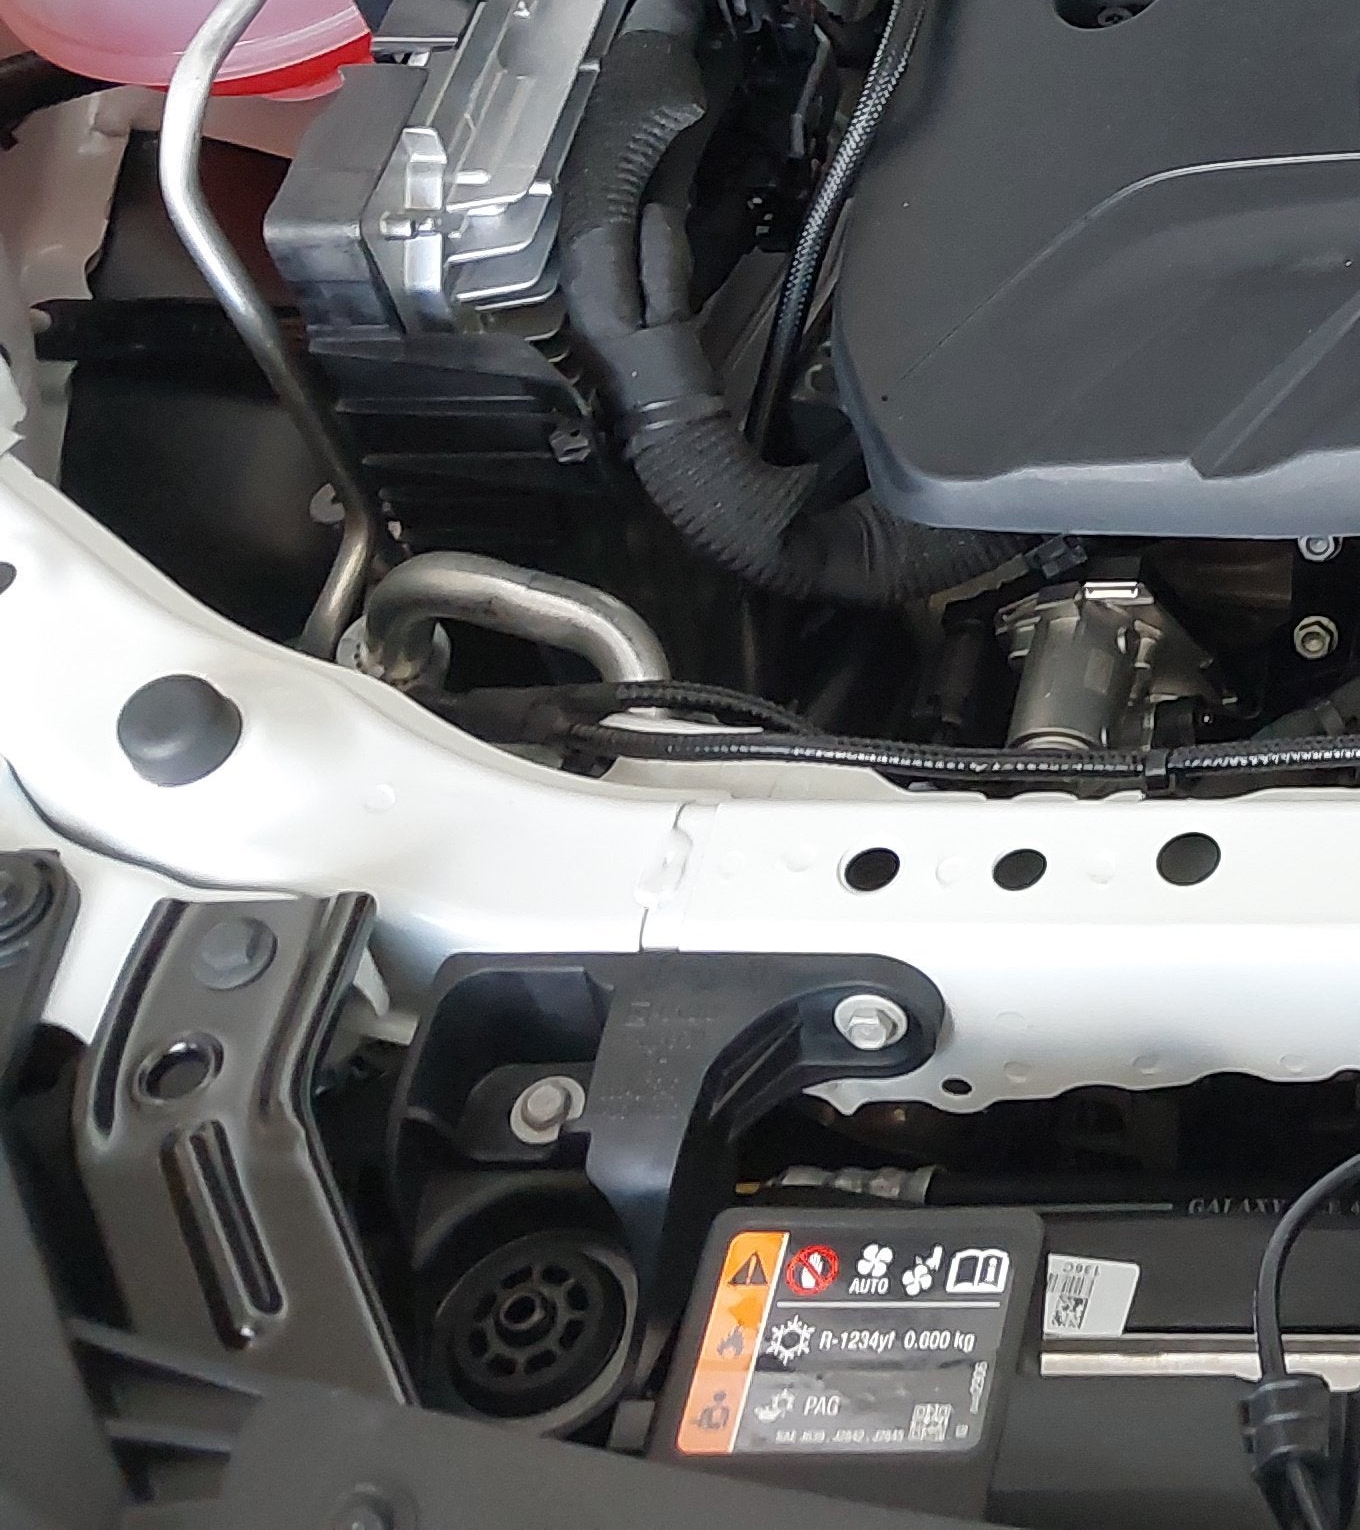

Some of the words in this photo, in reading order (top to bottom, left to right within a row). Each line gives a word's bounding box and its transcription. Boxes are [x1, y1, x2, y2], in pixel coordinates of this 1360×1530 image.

[849, 1277, 889, 1296] AUTO
[953, 1329, 976, 1354] kg
[804, 1395, 841, 1416] PAG
